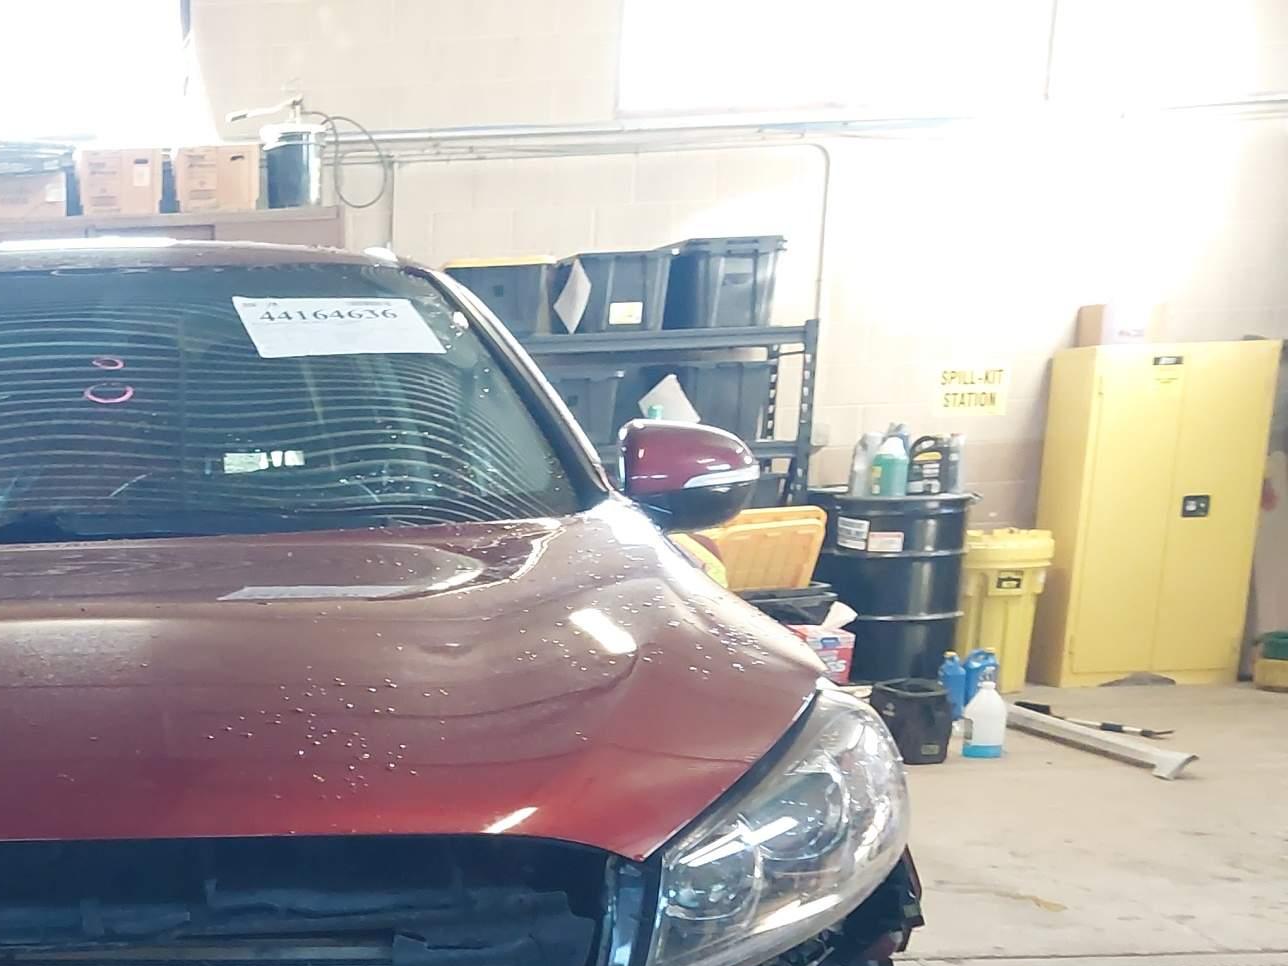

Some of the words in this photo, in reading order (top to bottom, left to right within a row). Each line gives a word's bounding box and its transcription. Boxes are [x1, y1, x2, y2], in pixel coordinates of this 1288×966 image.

[260, 308, 398, 322] 44164636
[940, 368, 1004, 385] SPILL-KIT
[943, 391, 997, 407] STATION
